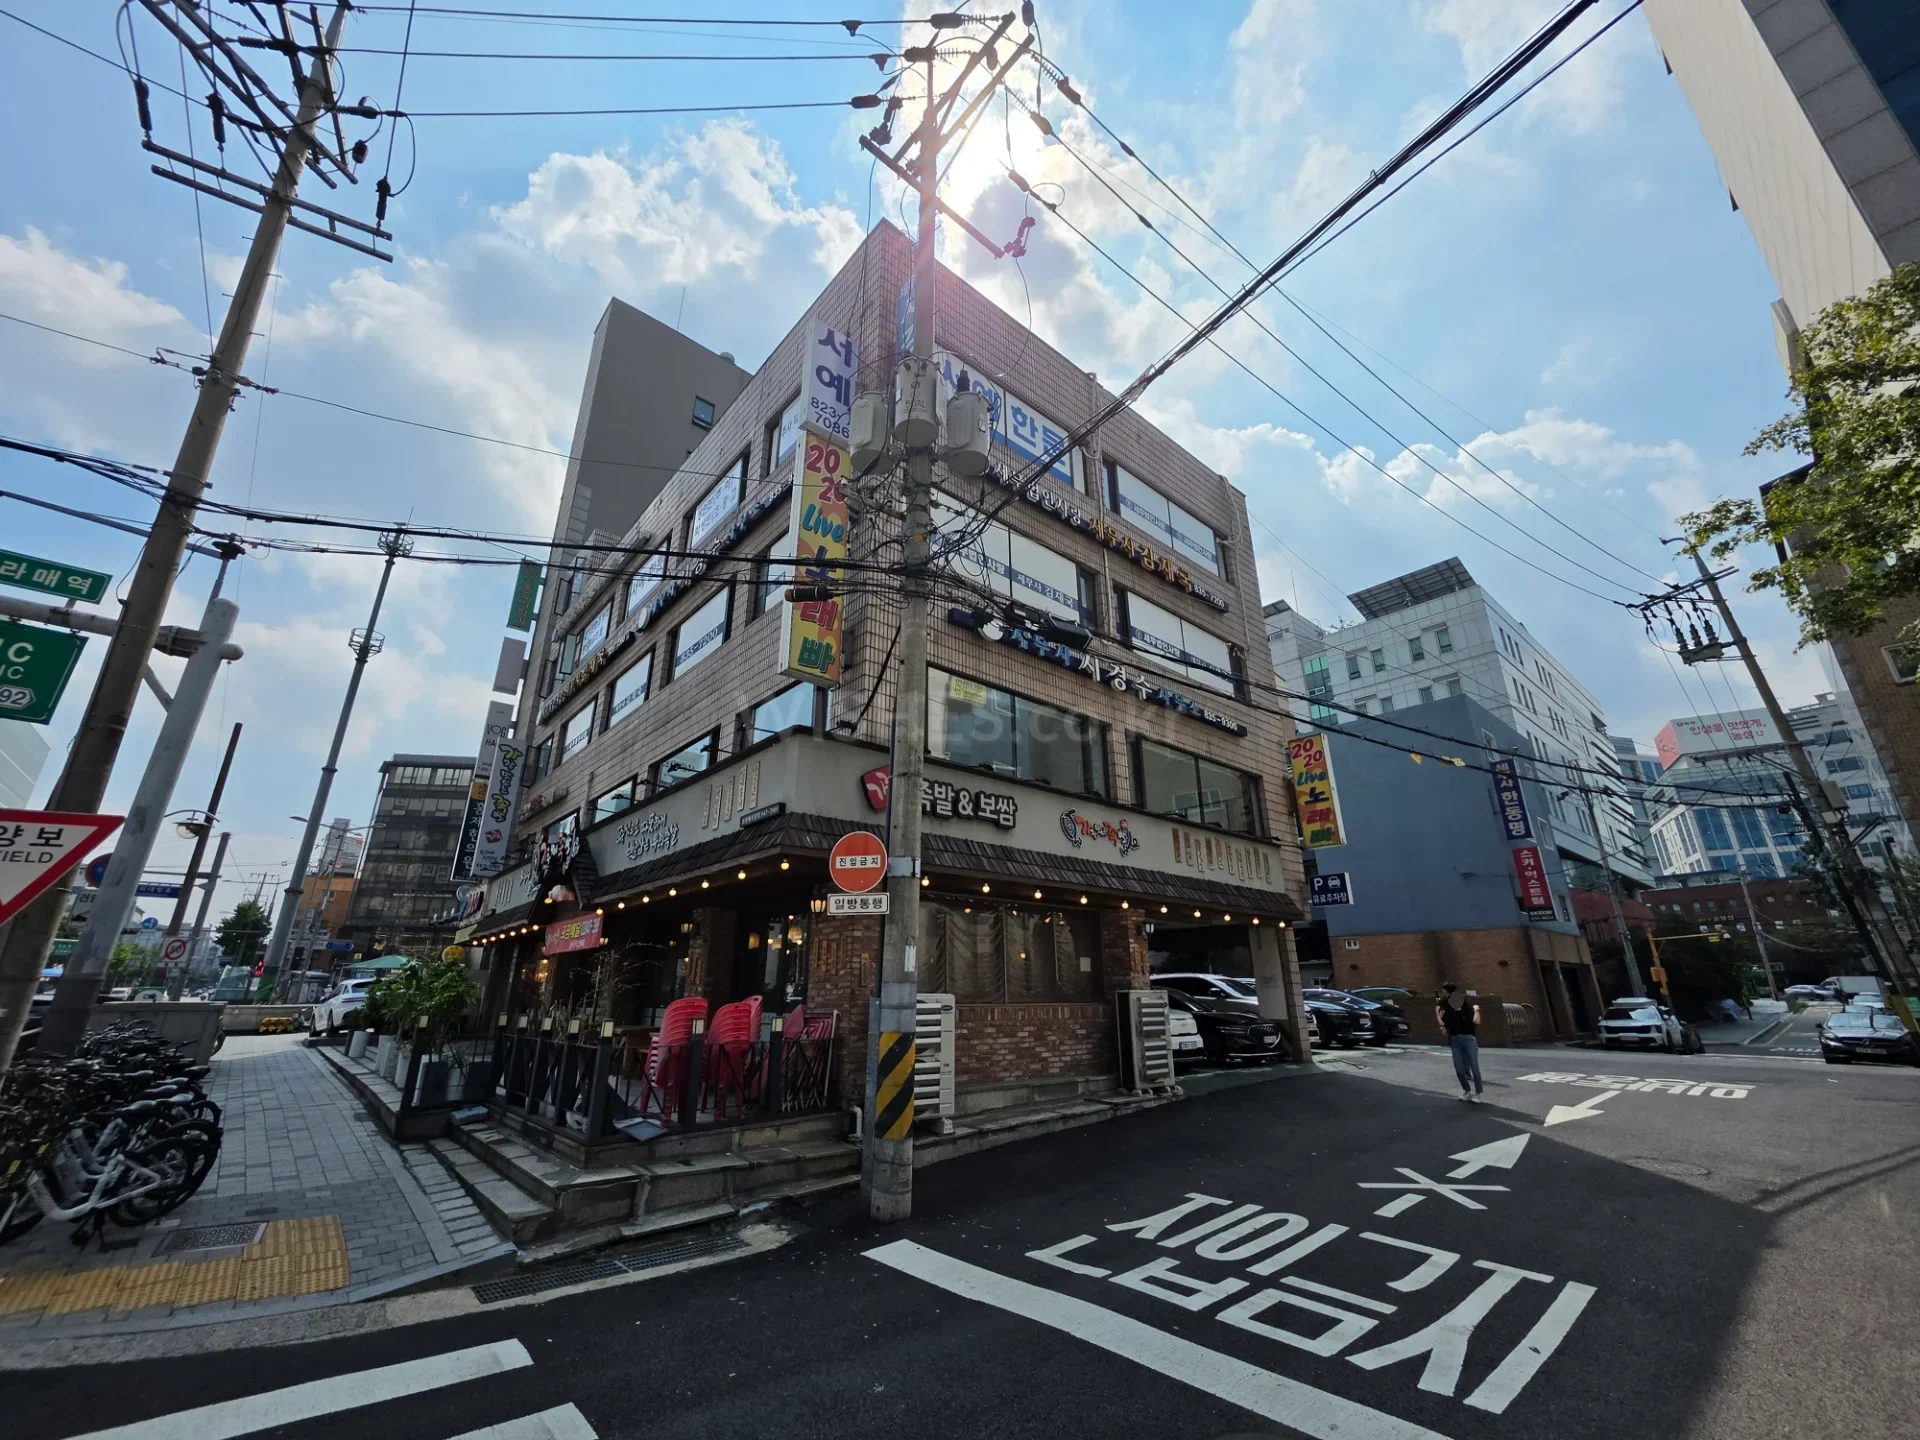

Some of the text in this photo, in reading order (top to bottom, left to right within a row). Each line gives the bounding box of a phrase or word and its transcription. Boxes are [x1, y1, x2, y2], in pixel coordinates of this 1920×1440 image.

[815, 327, 853, 408] 서예
[815, 411, 850, 439] 7086
[807, 443, 842, 475] 20
[802, 504, 845, 544] Live
[1016, 572, 1075, 610] 세무사 김재국
[1203, 710, 1238, 732] 835-9300
[1291, 738, 1314, 760] 20
[1303, 749, 1323, 768] 20
[1296, 771, 1326, 786] Live
[0, 850, 54, 864] IELD
[838, 856, 880, 867] 진입금지
[1313, 878, 1323, 891] P
[834, 897, 883, 911] 일방통행
[1312, 893, 1347, 903] 유료주차장
[1024, 1192, 1598, 1414] 진입금지
